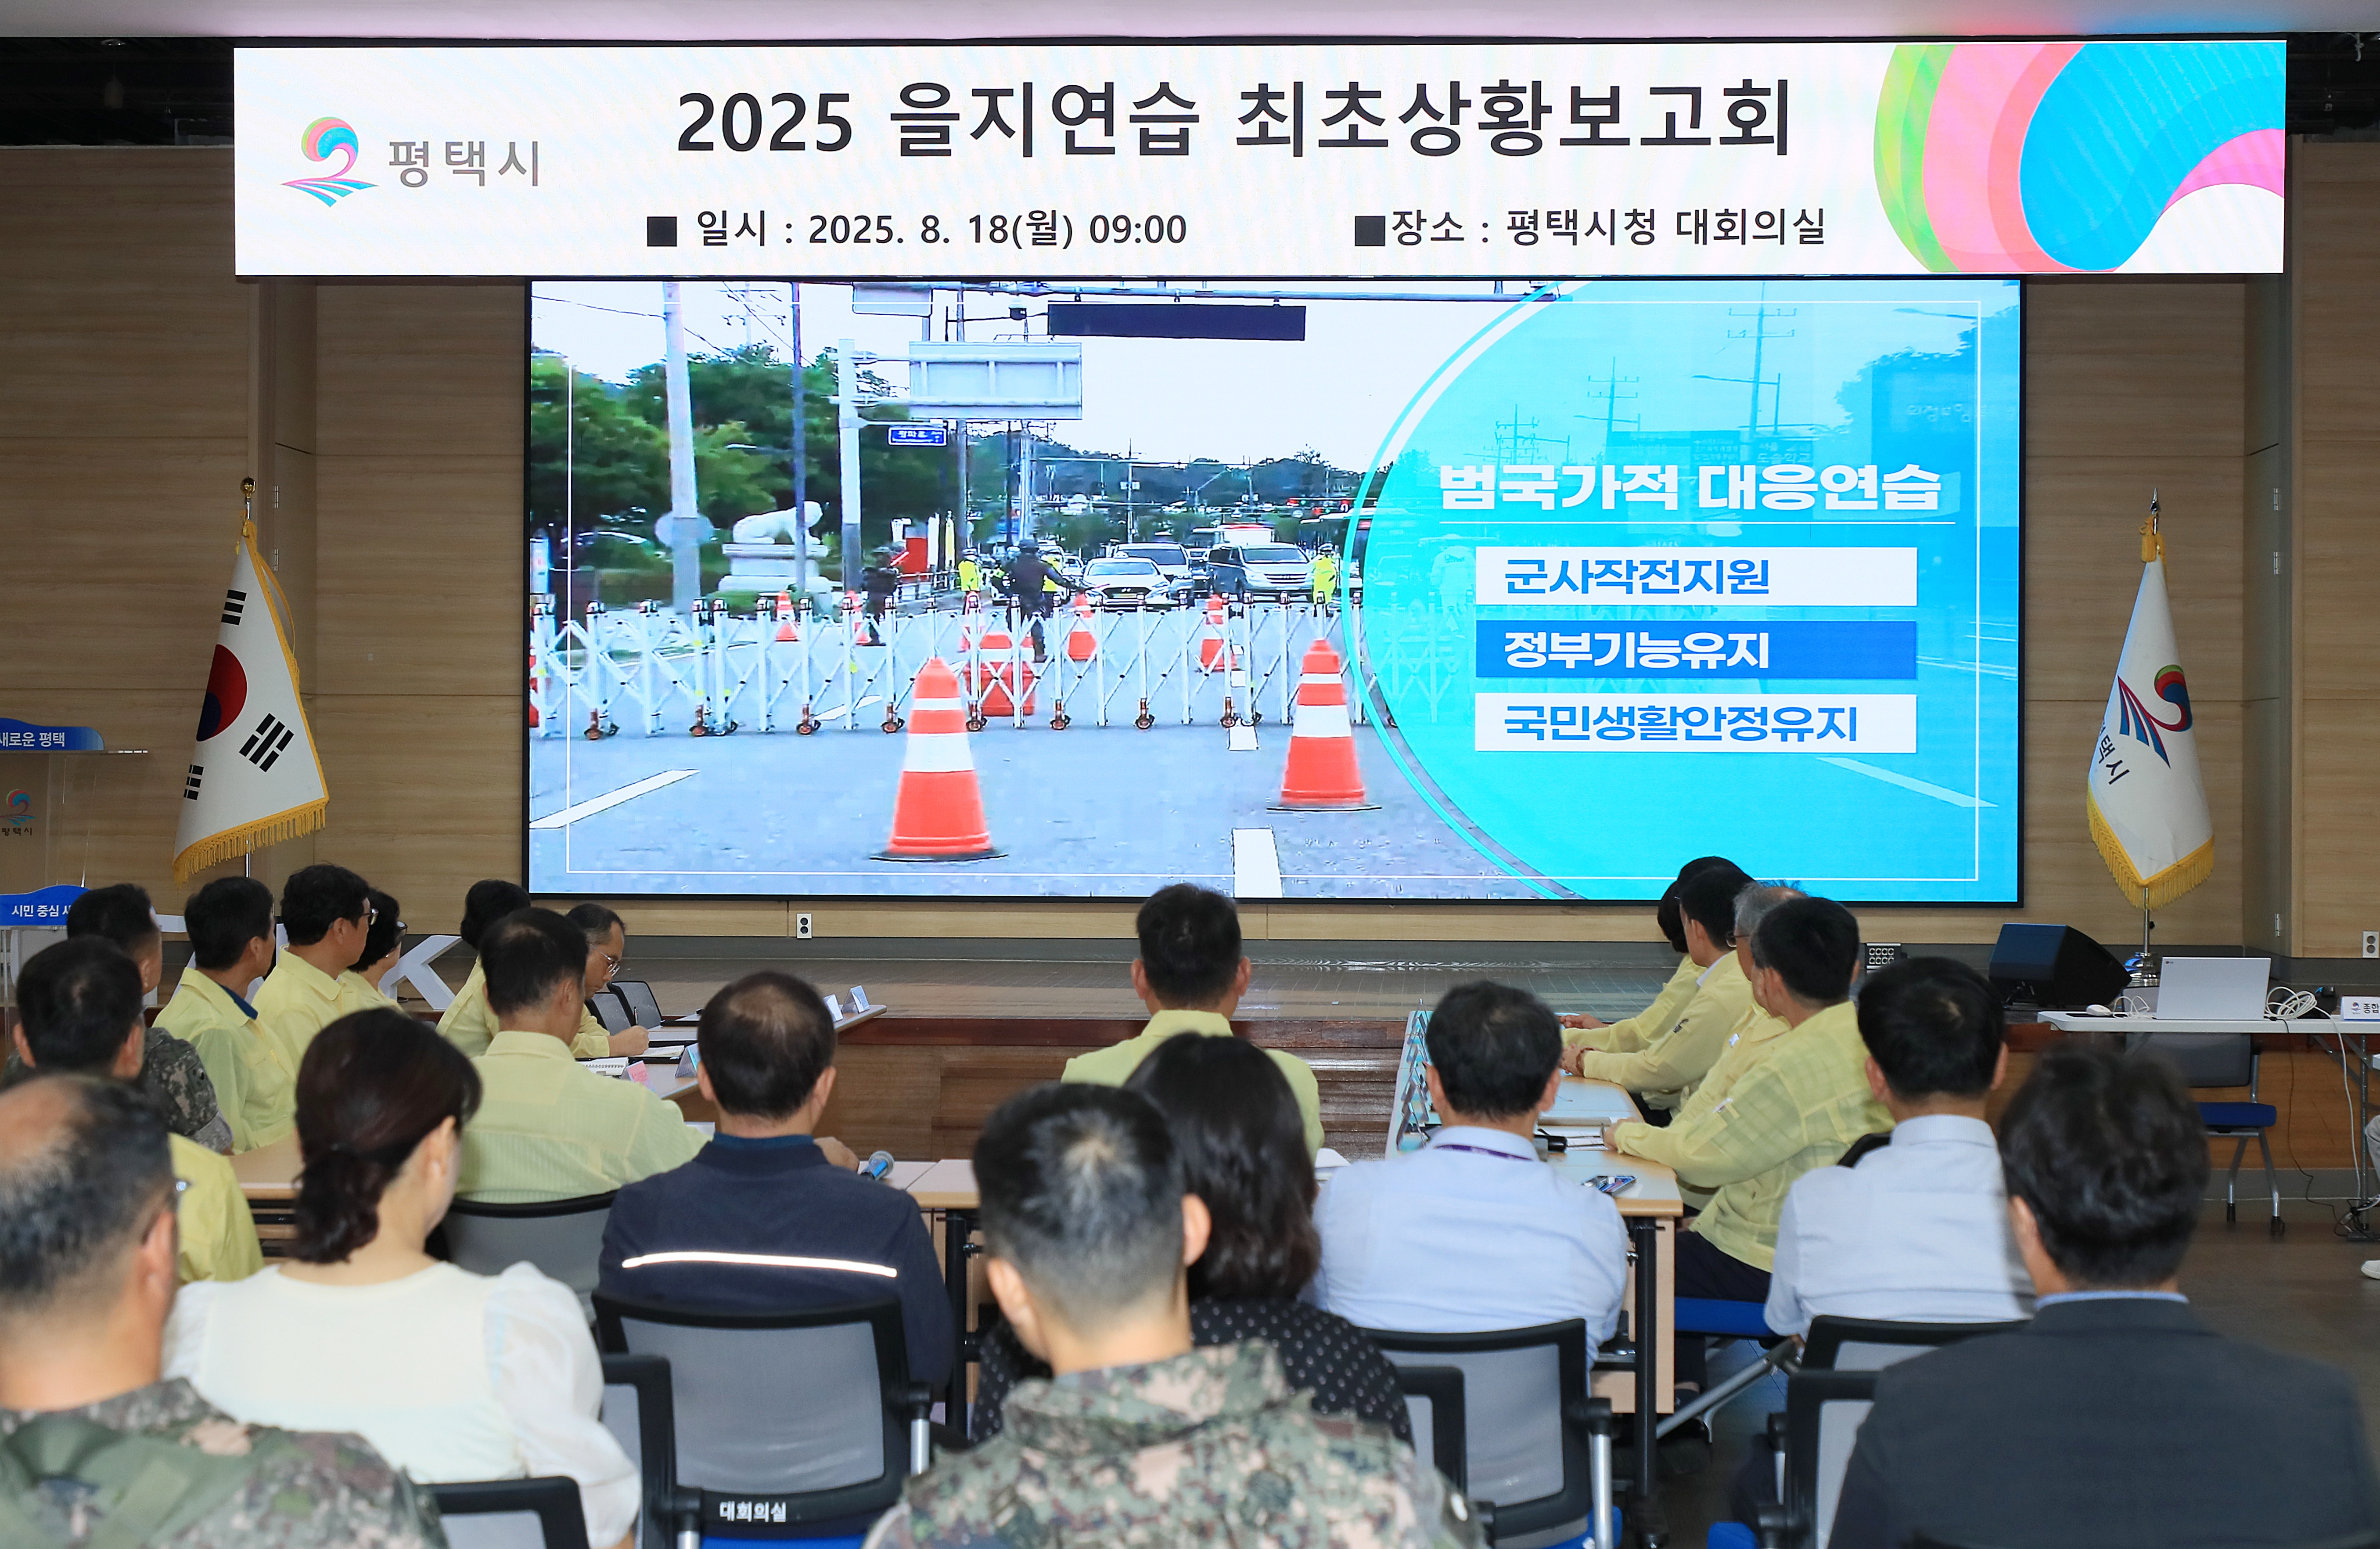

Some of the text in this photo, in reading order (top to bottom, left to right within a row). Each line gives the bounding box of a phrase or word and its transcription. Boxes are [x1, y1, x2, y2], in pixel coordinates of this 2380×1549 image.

[678, 78, 1788, 158] 2025 을지연습 최초상황보고회
[388, 140, 539, 188] 평택시
[697, 209, 765, 247] 일시
[809, 214, 904, 244] 2025.
[920, 214, 950, 244] 8.
[969, 209, 1073, 250] 18(월)
[1089, 214, 1186, 244] 09:00
[1391, 209, 1465, 246] 장소
[1506, 208, 1655, 247] 평택시청
[1676, 208, 1825, 246] 대회의실
[1439, 463, 1941, 511] 범국가적 대응연습
[1504, 559, 1769, 595] 군사작전지원
[1504, 631, 1769, 670] 정부기능유지
[0, 731, 65, 747] 새로운 평택
[1504, 705, 1857, 742] 국민생활안정유지
[2098, 722, 2130, 785] 택시
[1, 827, 32, 836] 평택시
[11, 904, 34, 917] 시민
[37, 904, 59, 917] 중심
[2363, 1003, 2380, 1014] 종합
[719, 1501, 787, 1523] 대회의실
